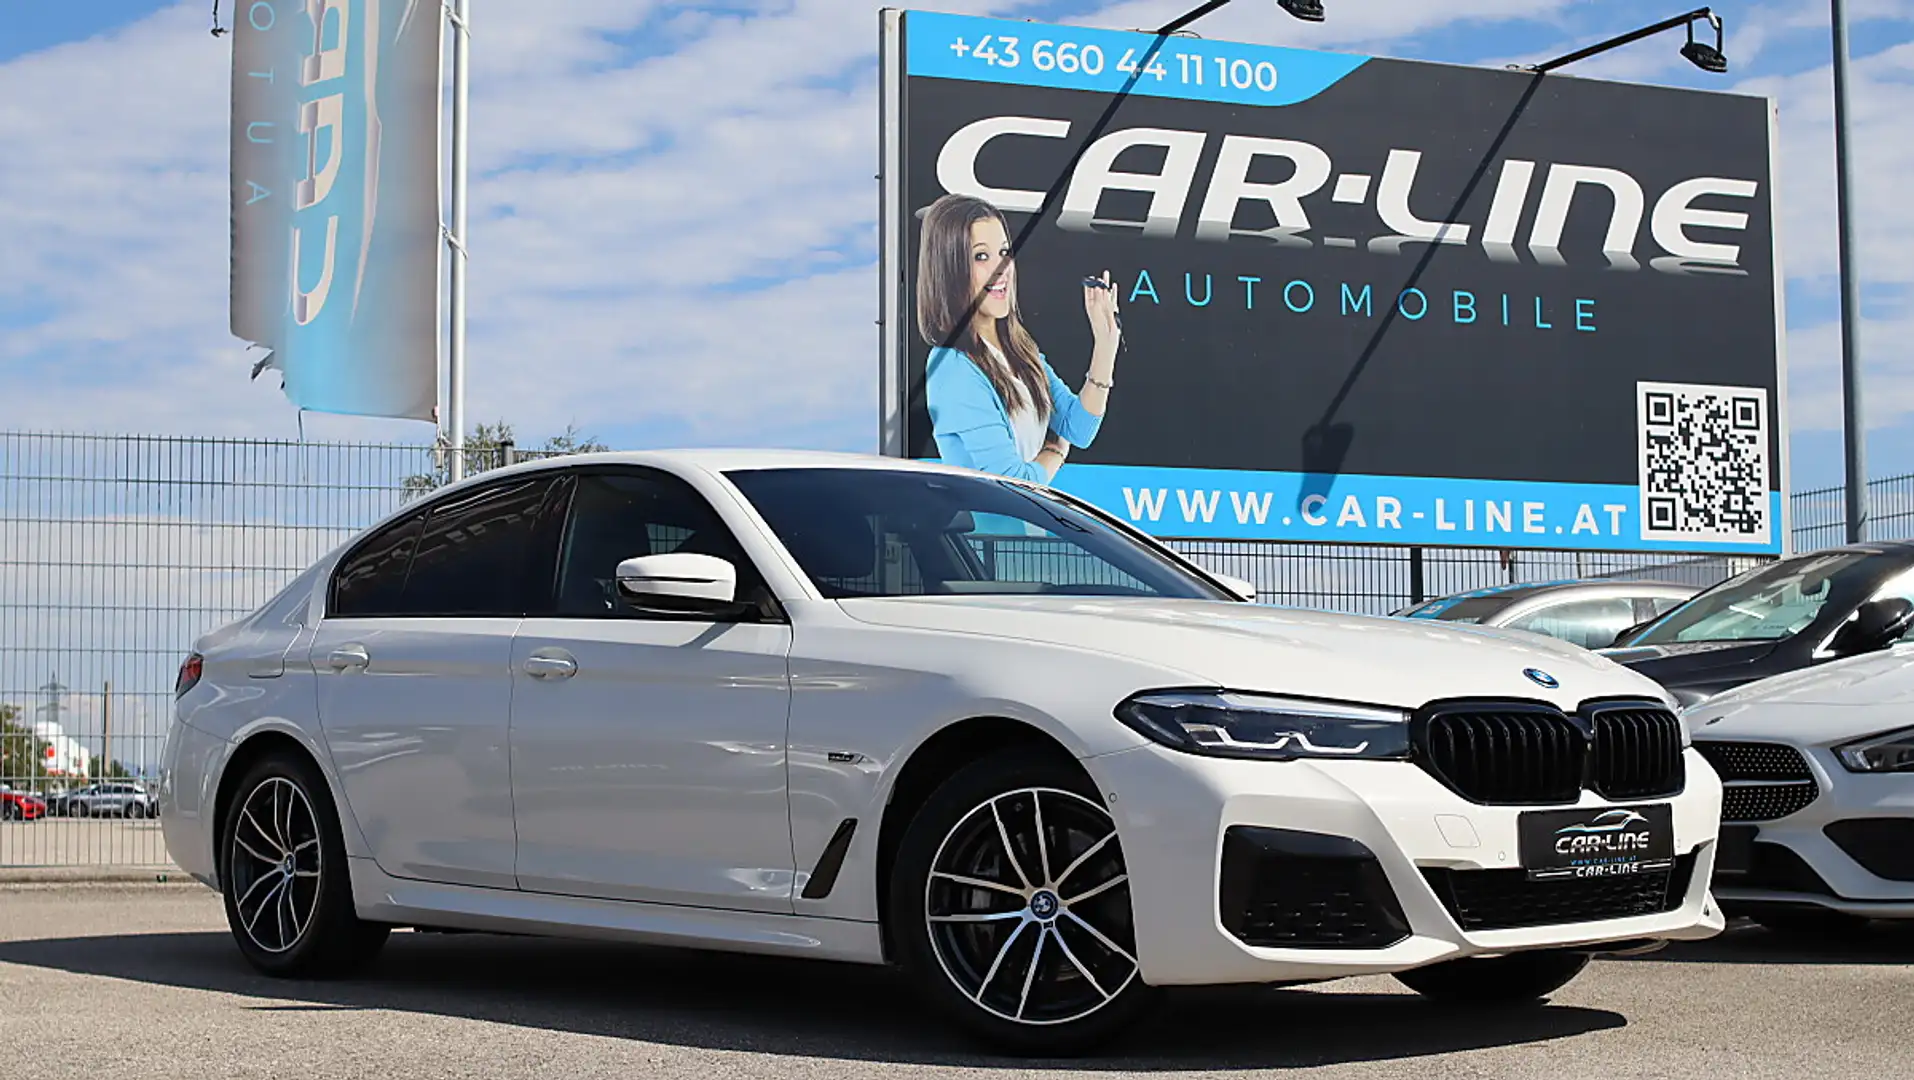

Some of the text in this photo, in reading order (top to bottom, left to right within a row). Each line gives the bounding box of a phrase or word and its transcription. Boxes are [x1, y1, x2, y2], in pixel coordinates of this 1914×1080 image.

[950, 35, 1278, 91] +43 660 44 11 100
[1129, 269, 1597, 331] AUTOMOBILE
[1122, 487, 1627, 536] WWW.CAR-LINE.AT
